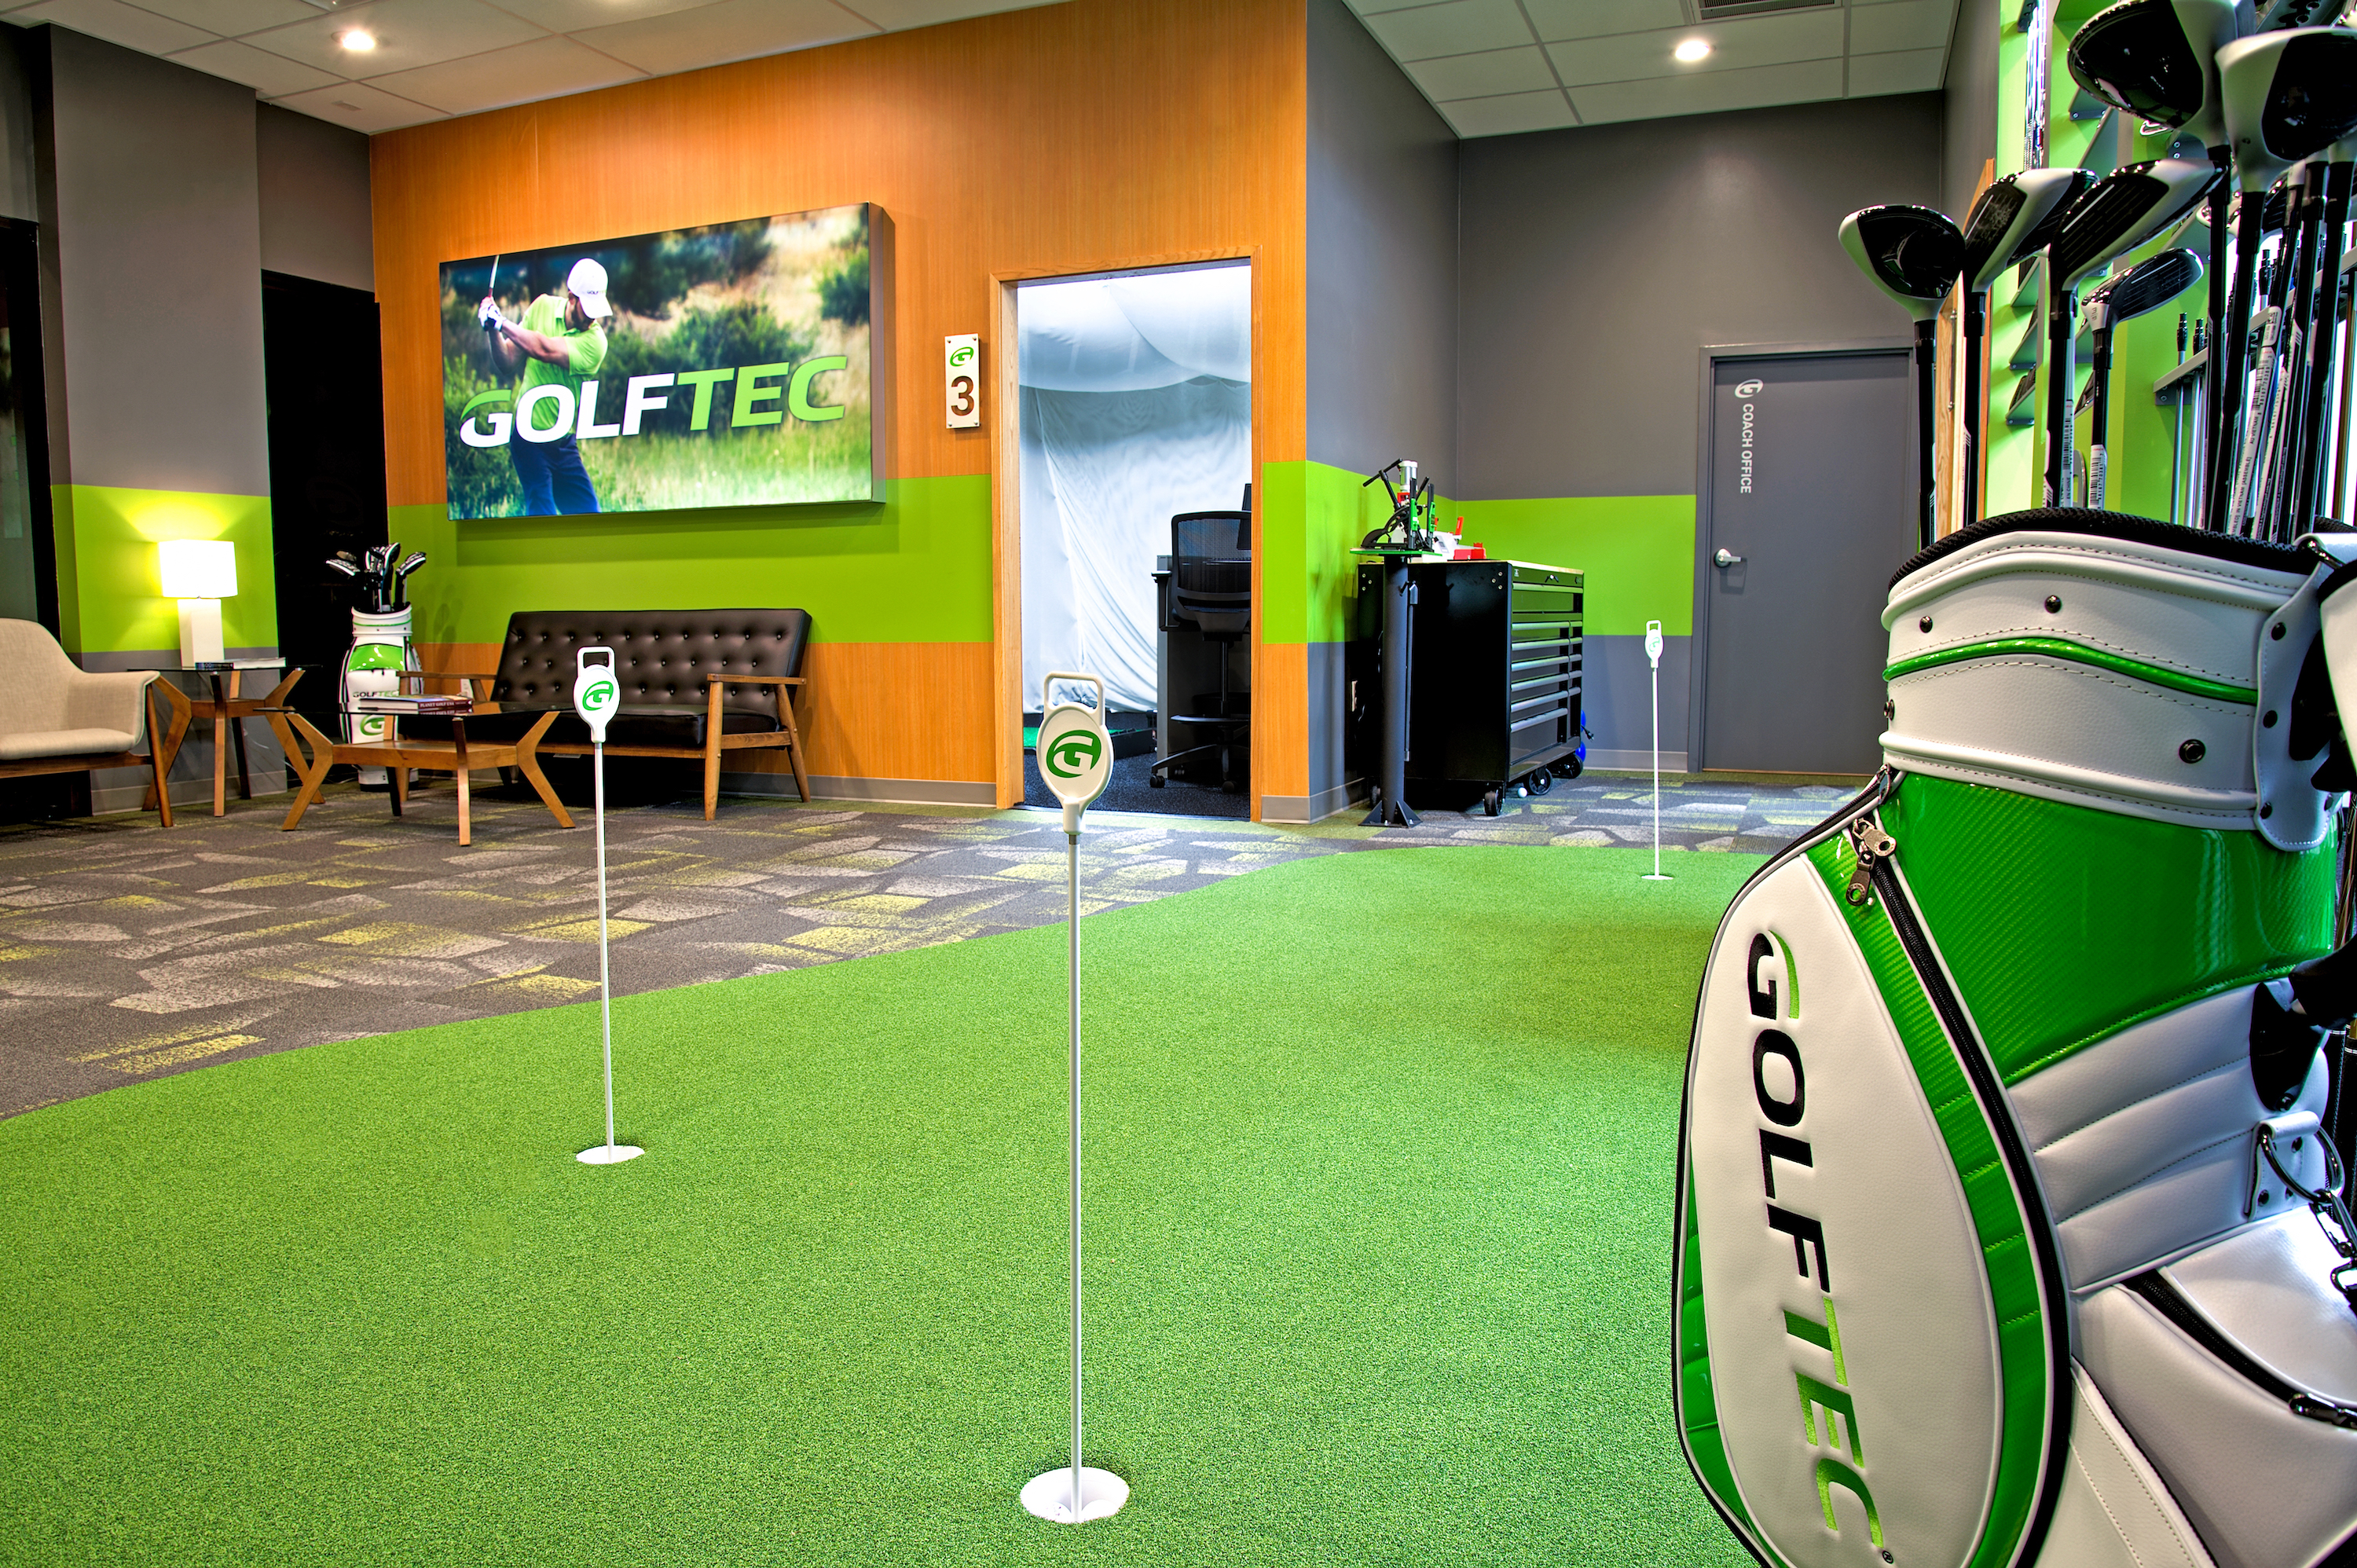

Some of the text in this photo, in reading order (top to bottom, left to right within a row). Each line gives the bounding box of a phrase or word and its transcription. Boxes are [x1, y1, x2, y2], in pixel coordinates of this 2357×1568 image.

[460, 356, 847, 448] GOLFTEC
[951, 376, 974, 416] 3
[1740, 403, 1754, 493] COACH OFFICE
[1747, 930, 1884, 1548] GOLFTEC
